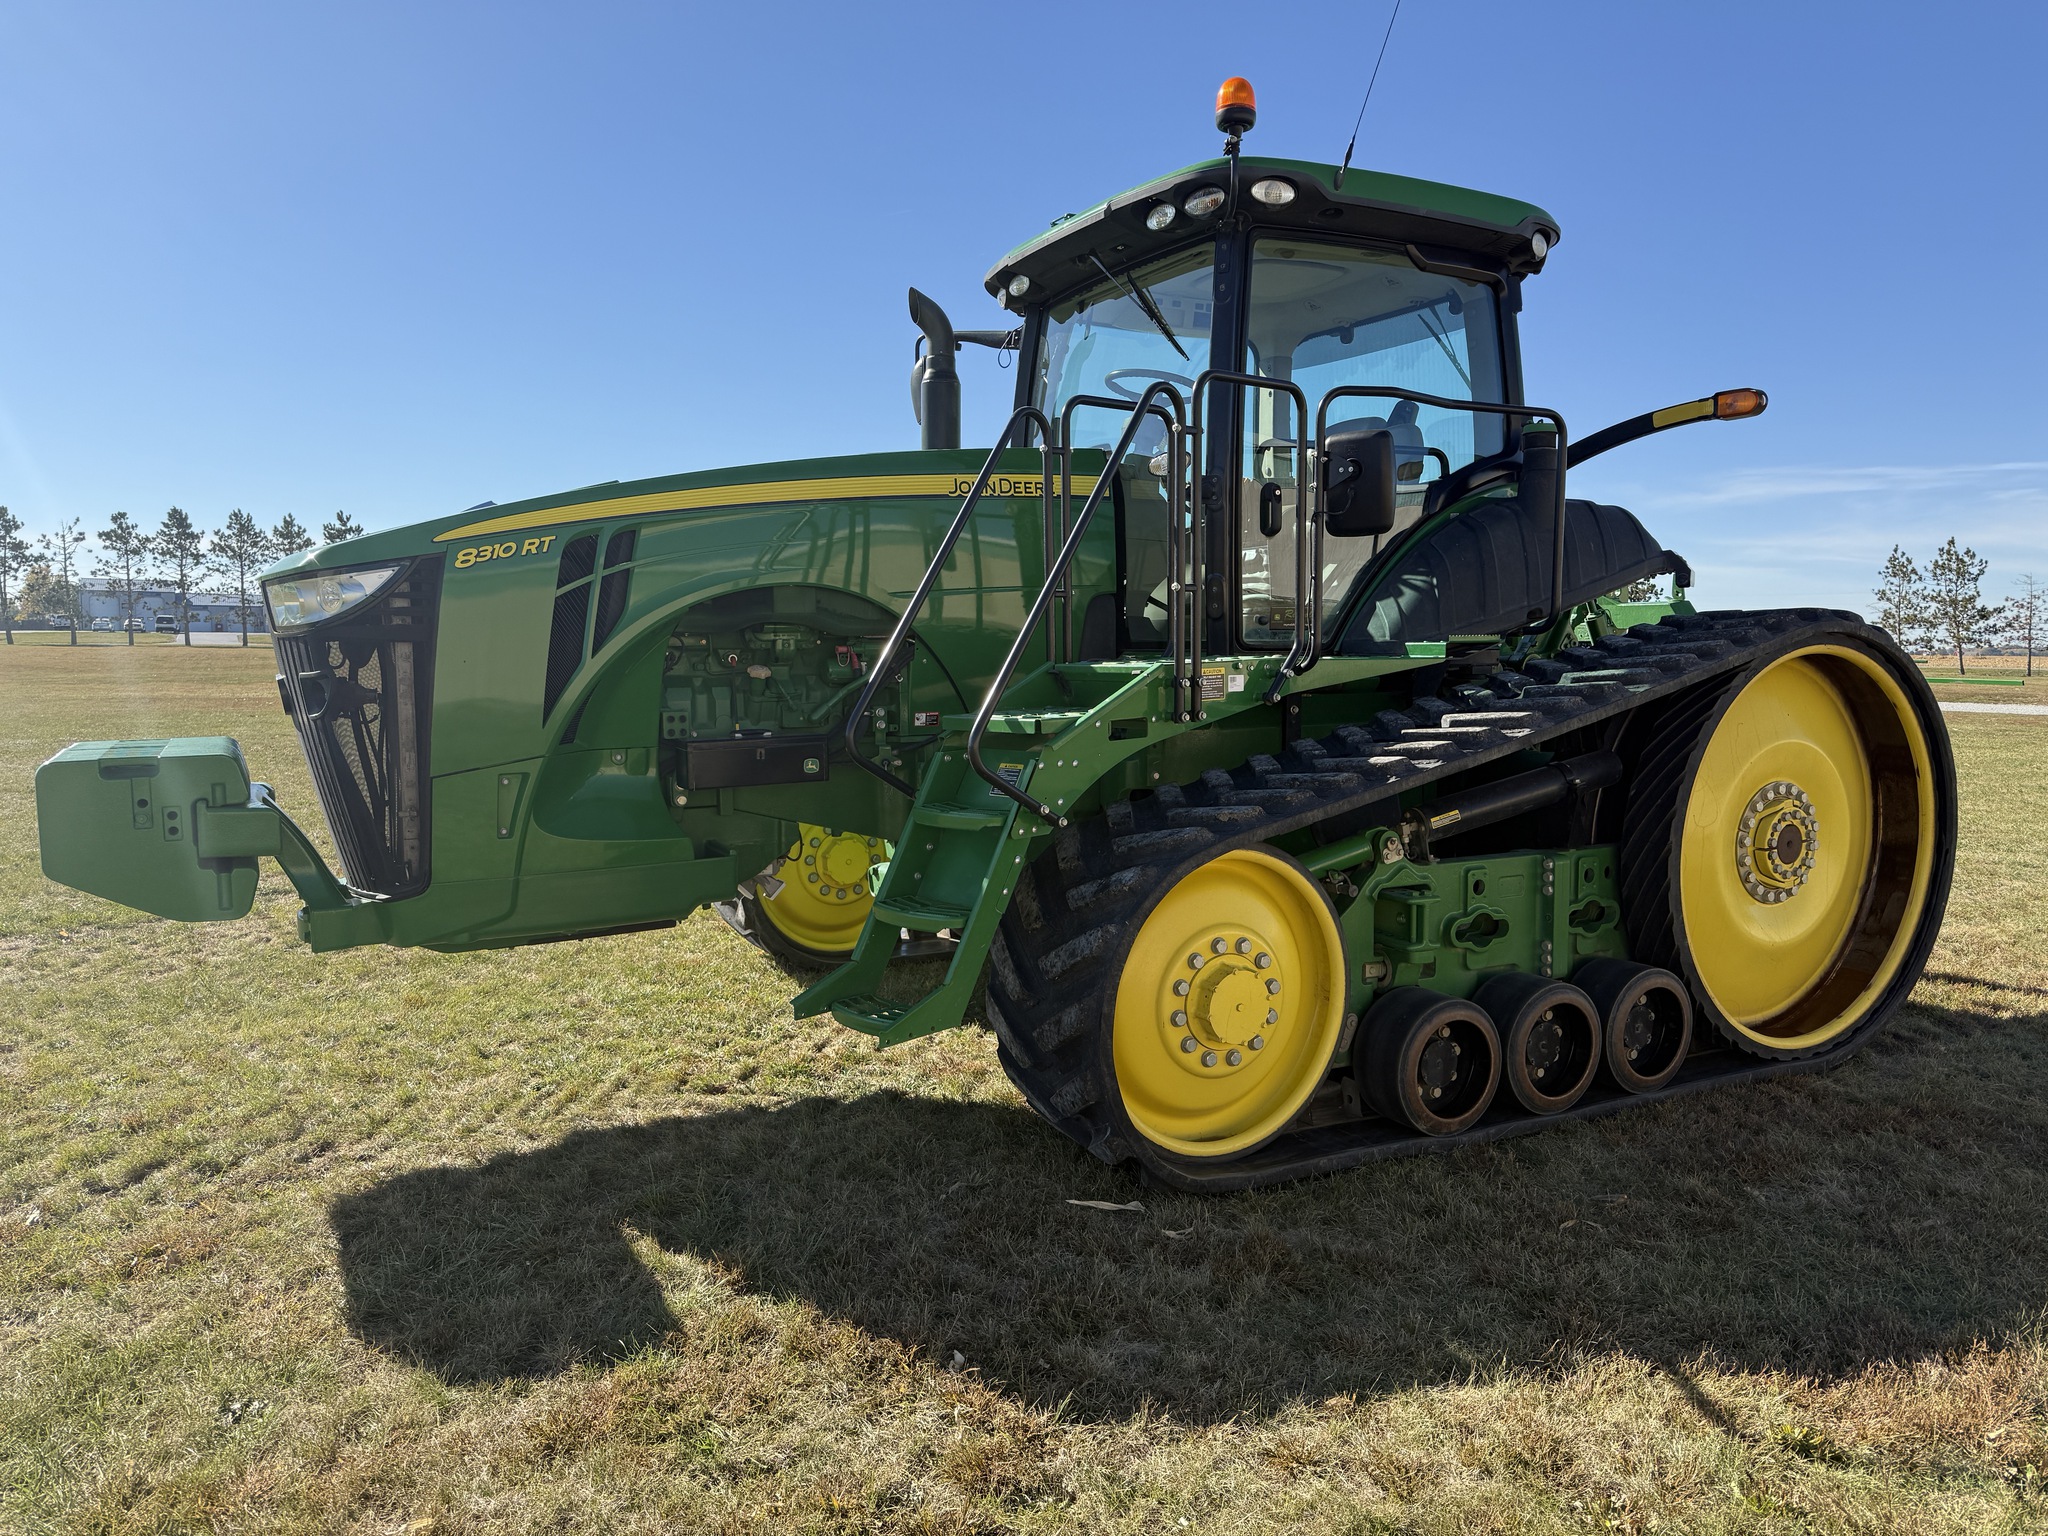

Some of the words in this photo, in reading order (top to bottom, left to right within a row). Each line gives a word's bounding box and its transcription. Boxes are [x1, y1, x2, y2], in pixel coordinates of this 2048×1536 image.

[949, 478, 996, 494] JON
[999, 478, 1056, 494] DEER
[454, 541, 517, 569] 8310
[521, 535, 557, 556] RT
